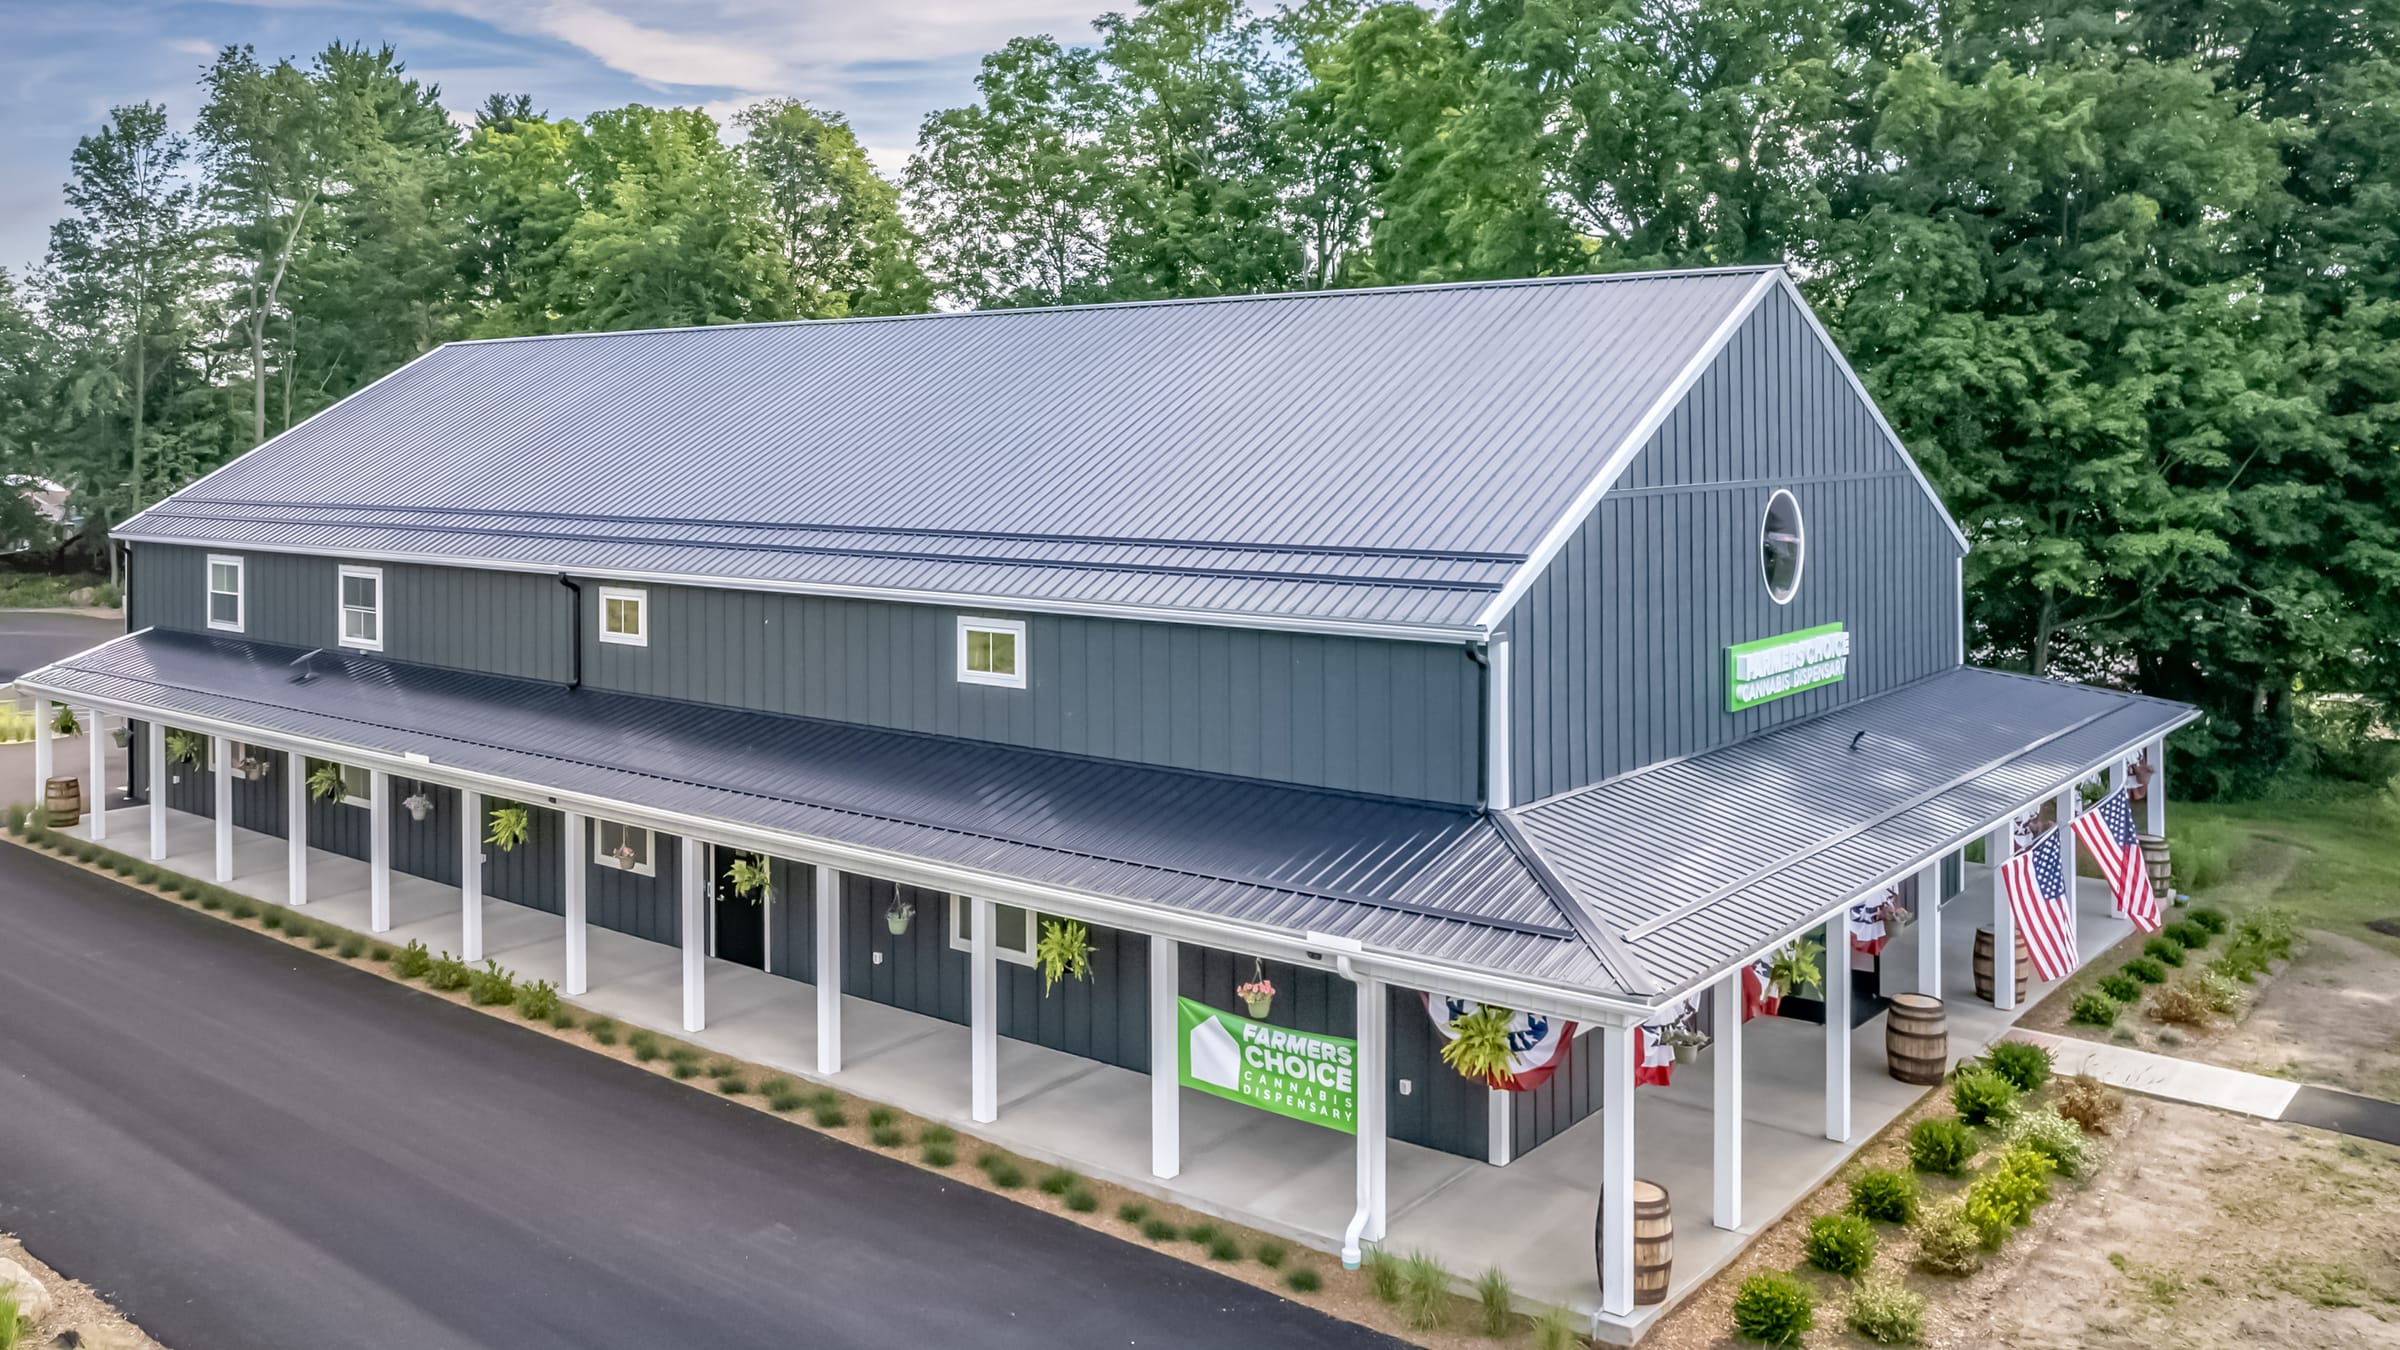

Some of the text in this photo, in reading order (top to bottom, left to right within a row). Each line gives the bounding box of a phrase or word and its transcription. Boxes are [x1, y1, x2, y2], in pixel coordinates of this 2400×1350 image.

[1737, 632, 1849, 681] FARMERS CHOICE
[1736, 657, 1847, 702] CANNABIS DISPENSARY
[1243, 1023, 1352, 1066] FARMERS
[1244, 1070, 1352, 1107] CANNABIS
[1245, 1046, 1352, 1093] CHOICE
[1243, 1084, 1352, 1121] DISPENSARY
